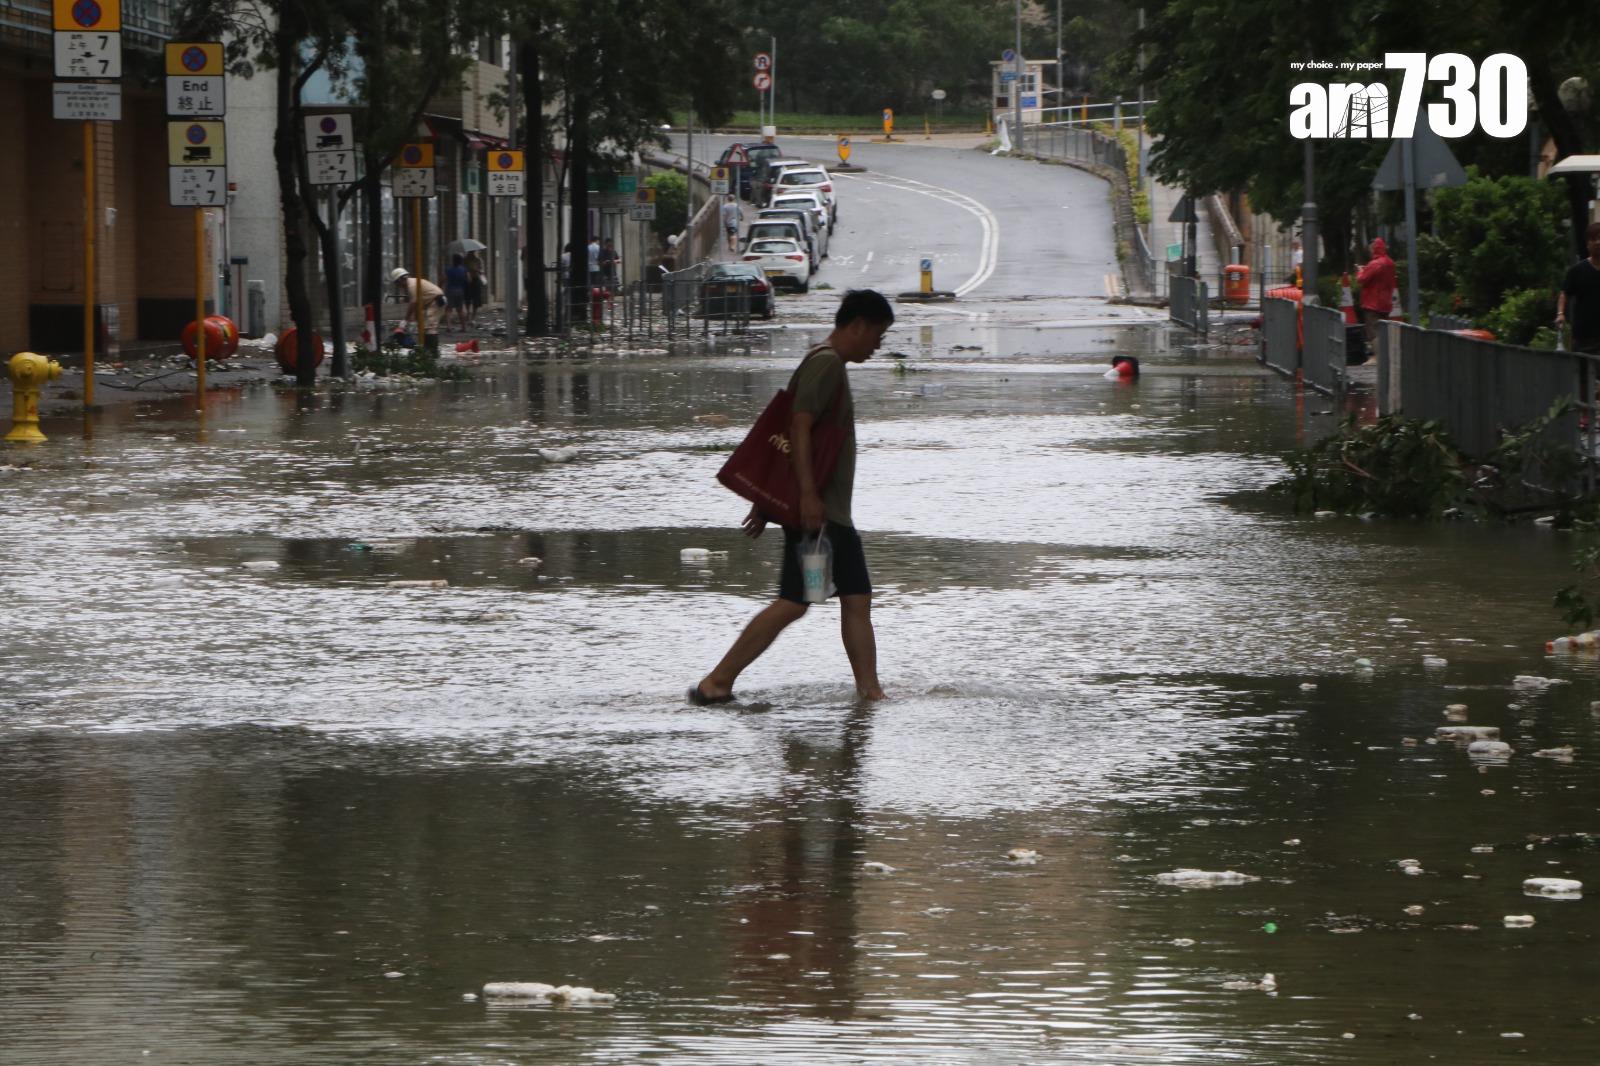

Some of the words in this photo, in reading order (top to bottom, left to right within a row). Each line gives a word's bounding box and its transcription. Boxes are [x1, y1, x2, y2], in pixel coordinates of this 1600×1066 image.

[97, 35, 108, 50] 7
[98, 59, 109, 74] 7
[182, 80, 209, 92] End
[177, 96, 214, 111] 終止
[337, 153, 346, 165] 7
[206, 169, 215, 182] 7
[338, 170, 347, 181] 7
[419, 169, 427, 179] 7
[492, 173, 504, 181] 24
[505, 173, 519, 181] hrs
[419, 185, 427, 195] 7
[495, 183, 517, 193] 全日
[207, 190, 216, 203] 7
